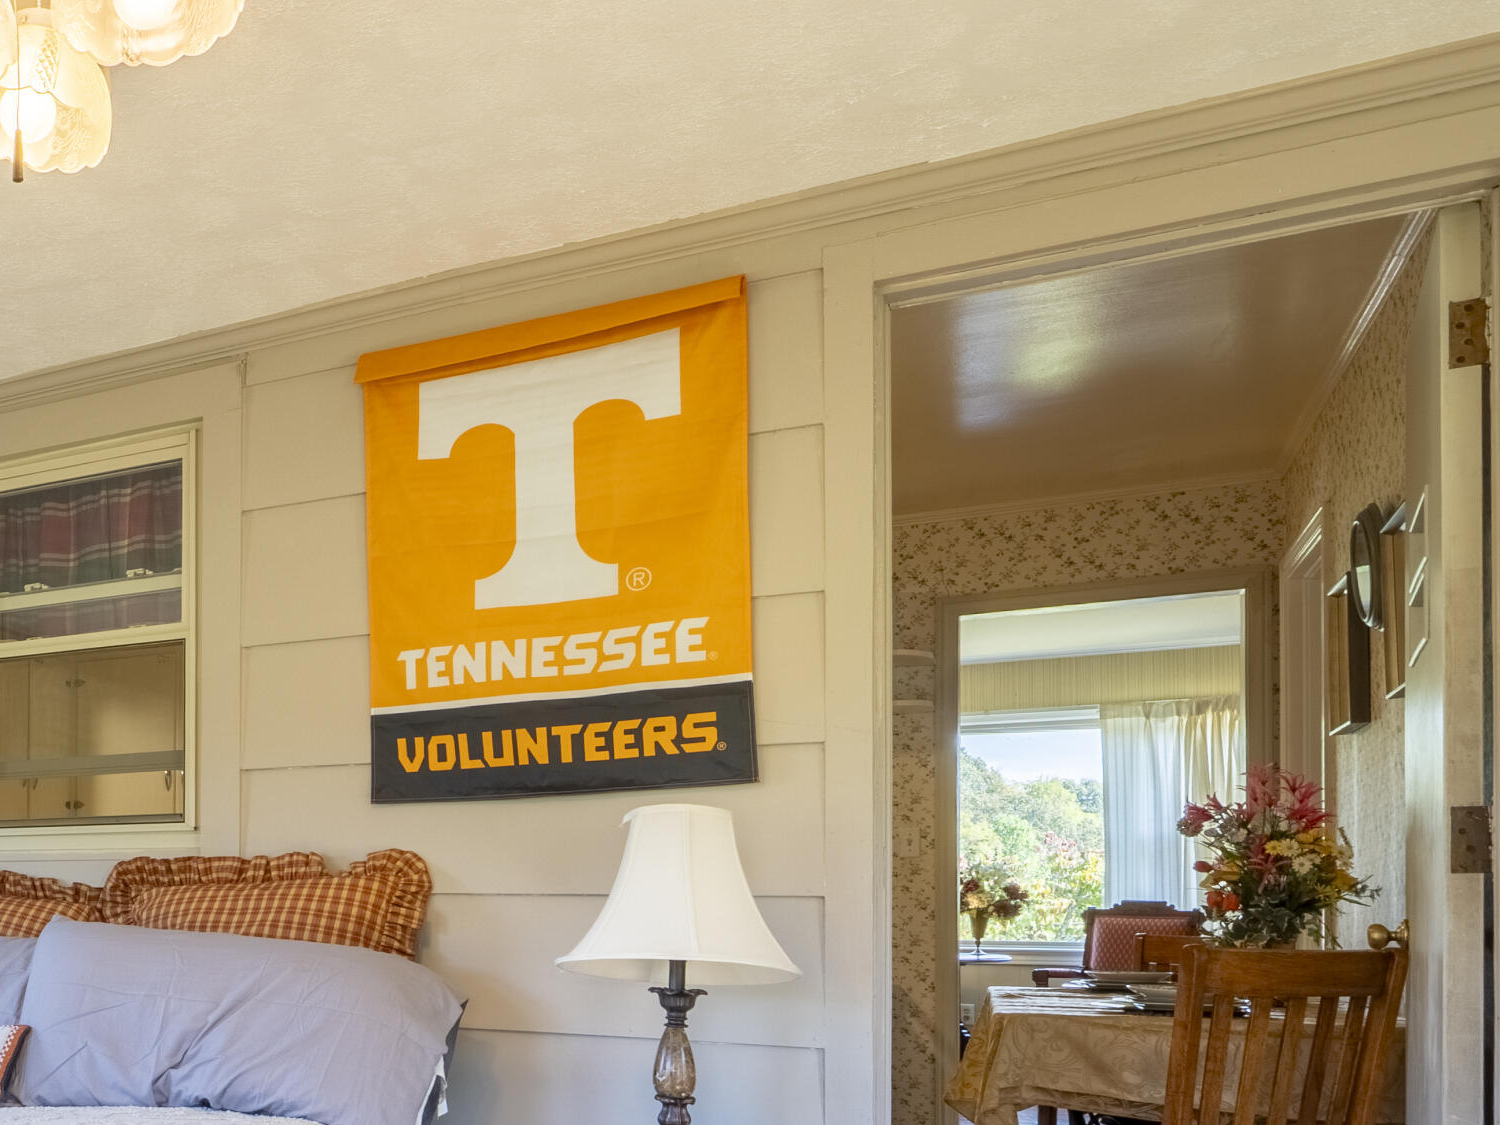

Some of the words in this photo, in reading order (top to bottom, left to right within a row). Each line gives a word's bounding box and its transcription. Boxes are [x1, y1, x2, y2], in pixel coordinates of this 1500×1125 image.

[418, 327, 681, 610] T
[397, 616, 709, 690] TENNESSEE
[397, 711, 718, 773] VOLUNTEERS
